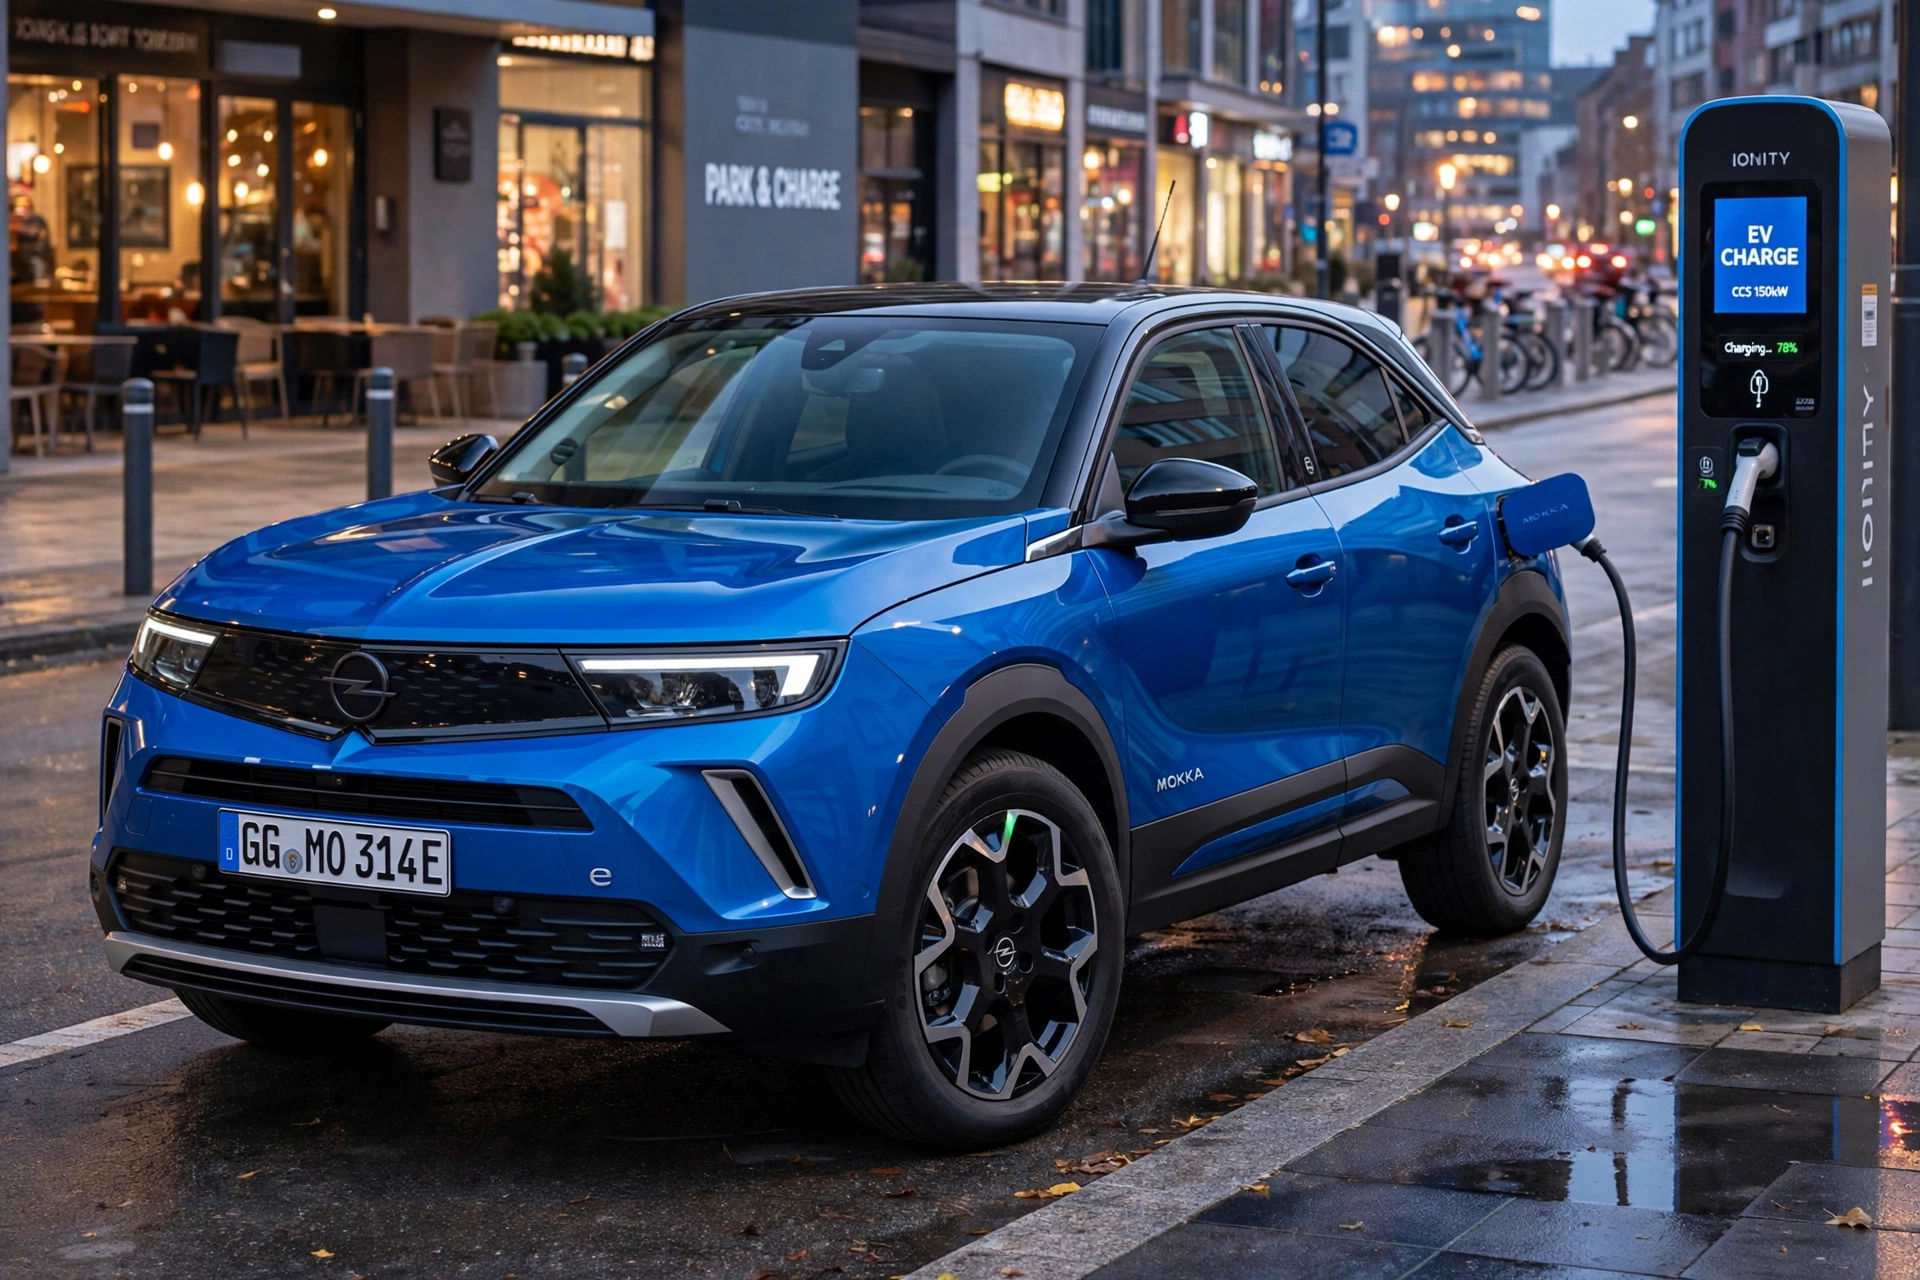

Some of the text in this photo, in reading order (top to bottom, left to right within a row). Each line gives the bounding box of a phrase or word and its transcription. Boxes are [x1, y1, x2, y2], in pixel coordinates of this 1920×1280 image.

[1732, 152, 1790, 167] IONITY
[705, 162, 842, 211] PARK & CHARGE
[1748, 225, 1774, 244] EV
[1720, 247, 1799, 266] CHARGE
[1731, 285, 1789, 298] CCS 150kW
[1776, 342, 1798, 353] 78%
[1156, 767, 1205, 792] MOKKA
[225, 847, 234, 861] D
[242, 821, 443, 886] GG MO 314E
[589, 867, 612, 887] e
